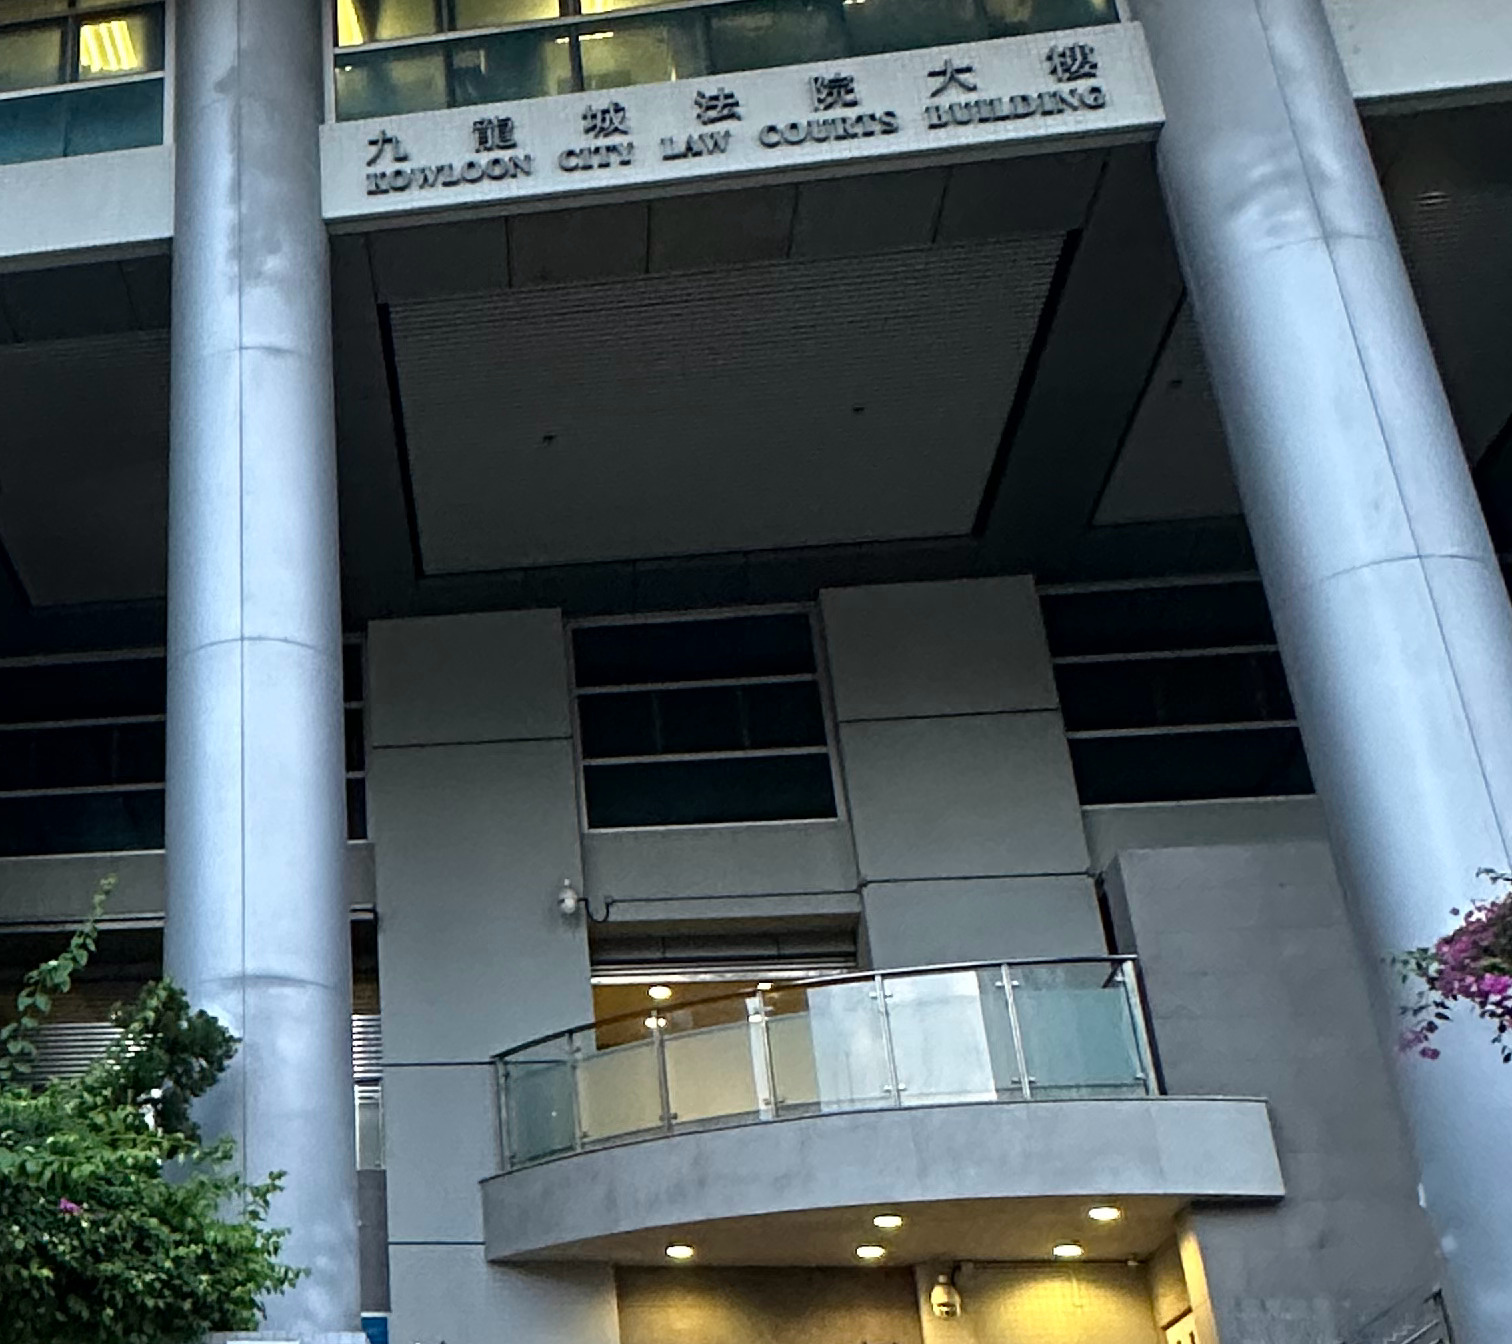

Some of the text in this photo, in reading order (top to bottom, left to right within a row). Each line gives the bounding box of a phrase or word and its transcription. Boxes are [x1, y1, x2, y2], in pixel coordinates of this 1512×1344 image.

[366, 42, 1099, 166] 九龍城法院大樓
[366, 85, 1107, 196] KOWLOON CITY LAW COURTS BUILDING
